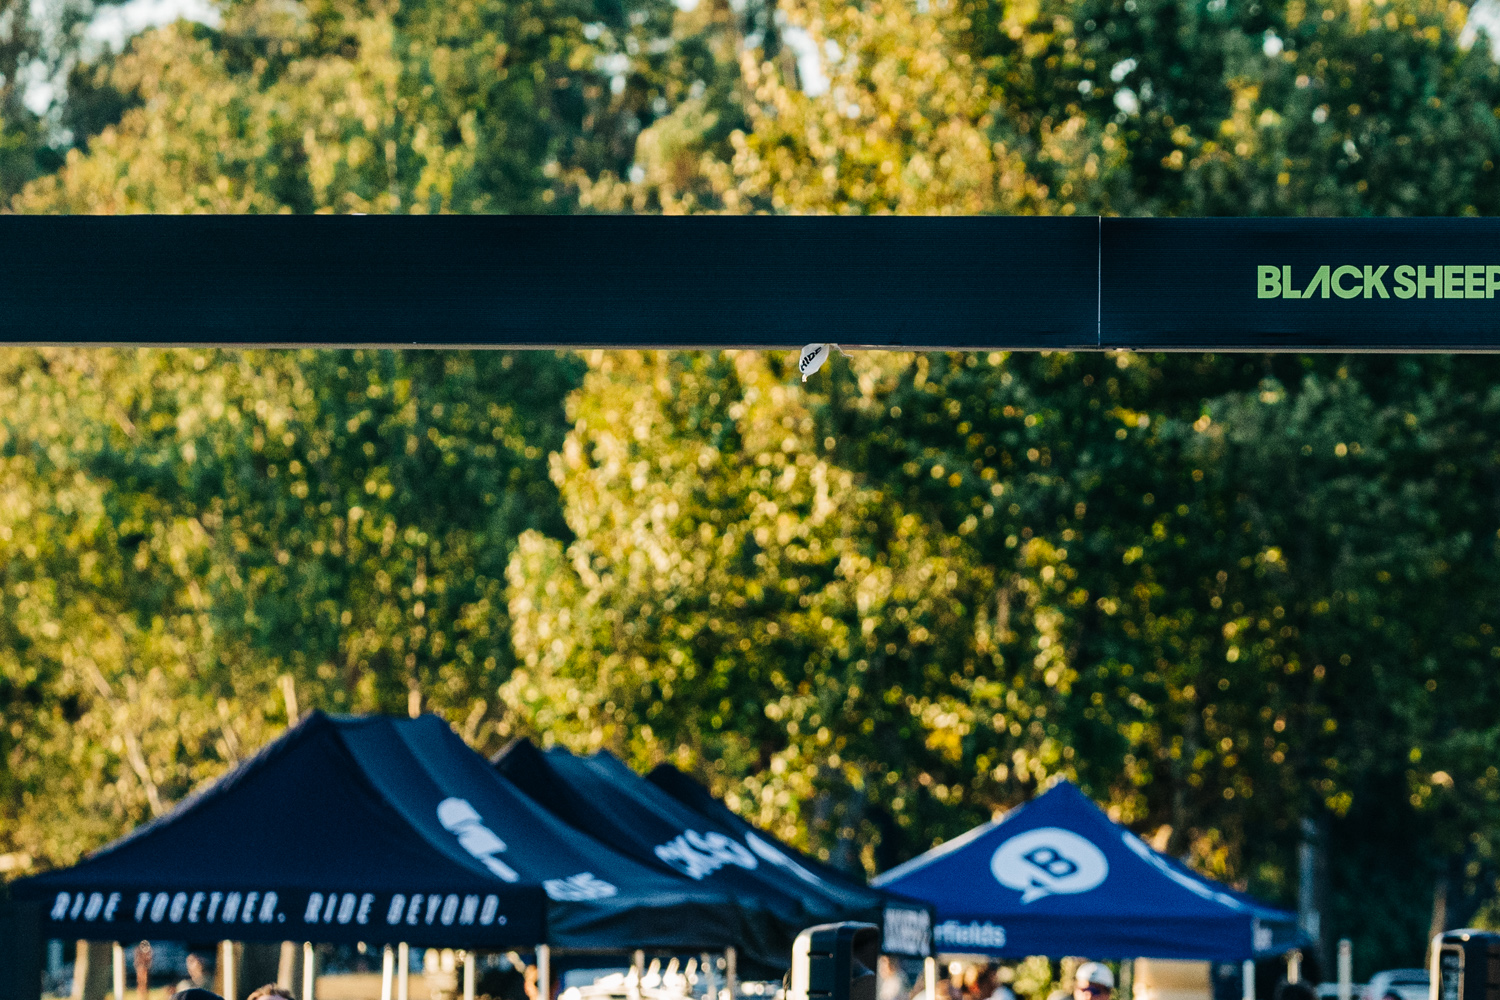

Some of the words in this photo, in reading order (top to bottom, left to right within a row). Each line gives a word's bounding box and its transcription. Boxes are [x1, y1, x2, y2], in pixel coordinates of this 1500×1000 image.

[1257, 264, 1390, 299] BLACK
[51, 891, 121, 922] RIDE
[134, 891, 286, 924] TOGETHER.
[304, 892, 375, 925] RIDE
[386, 893, 507, 926] BEYOND.
